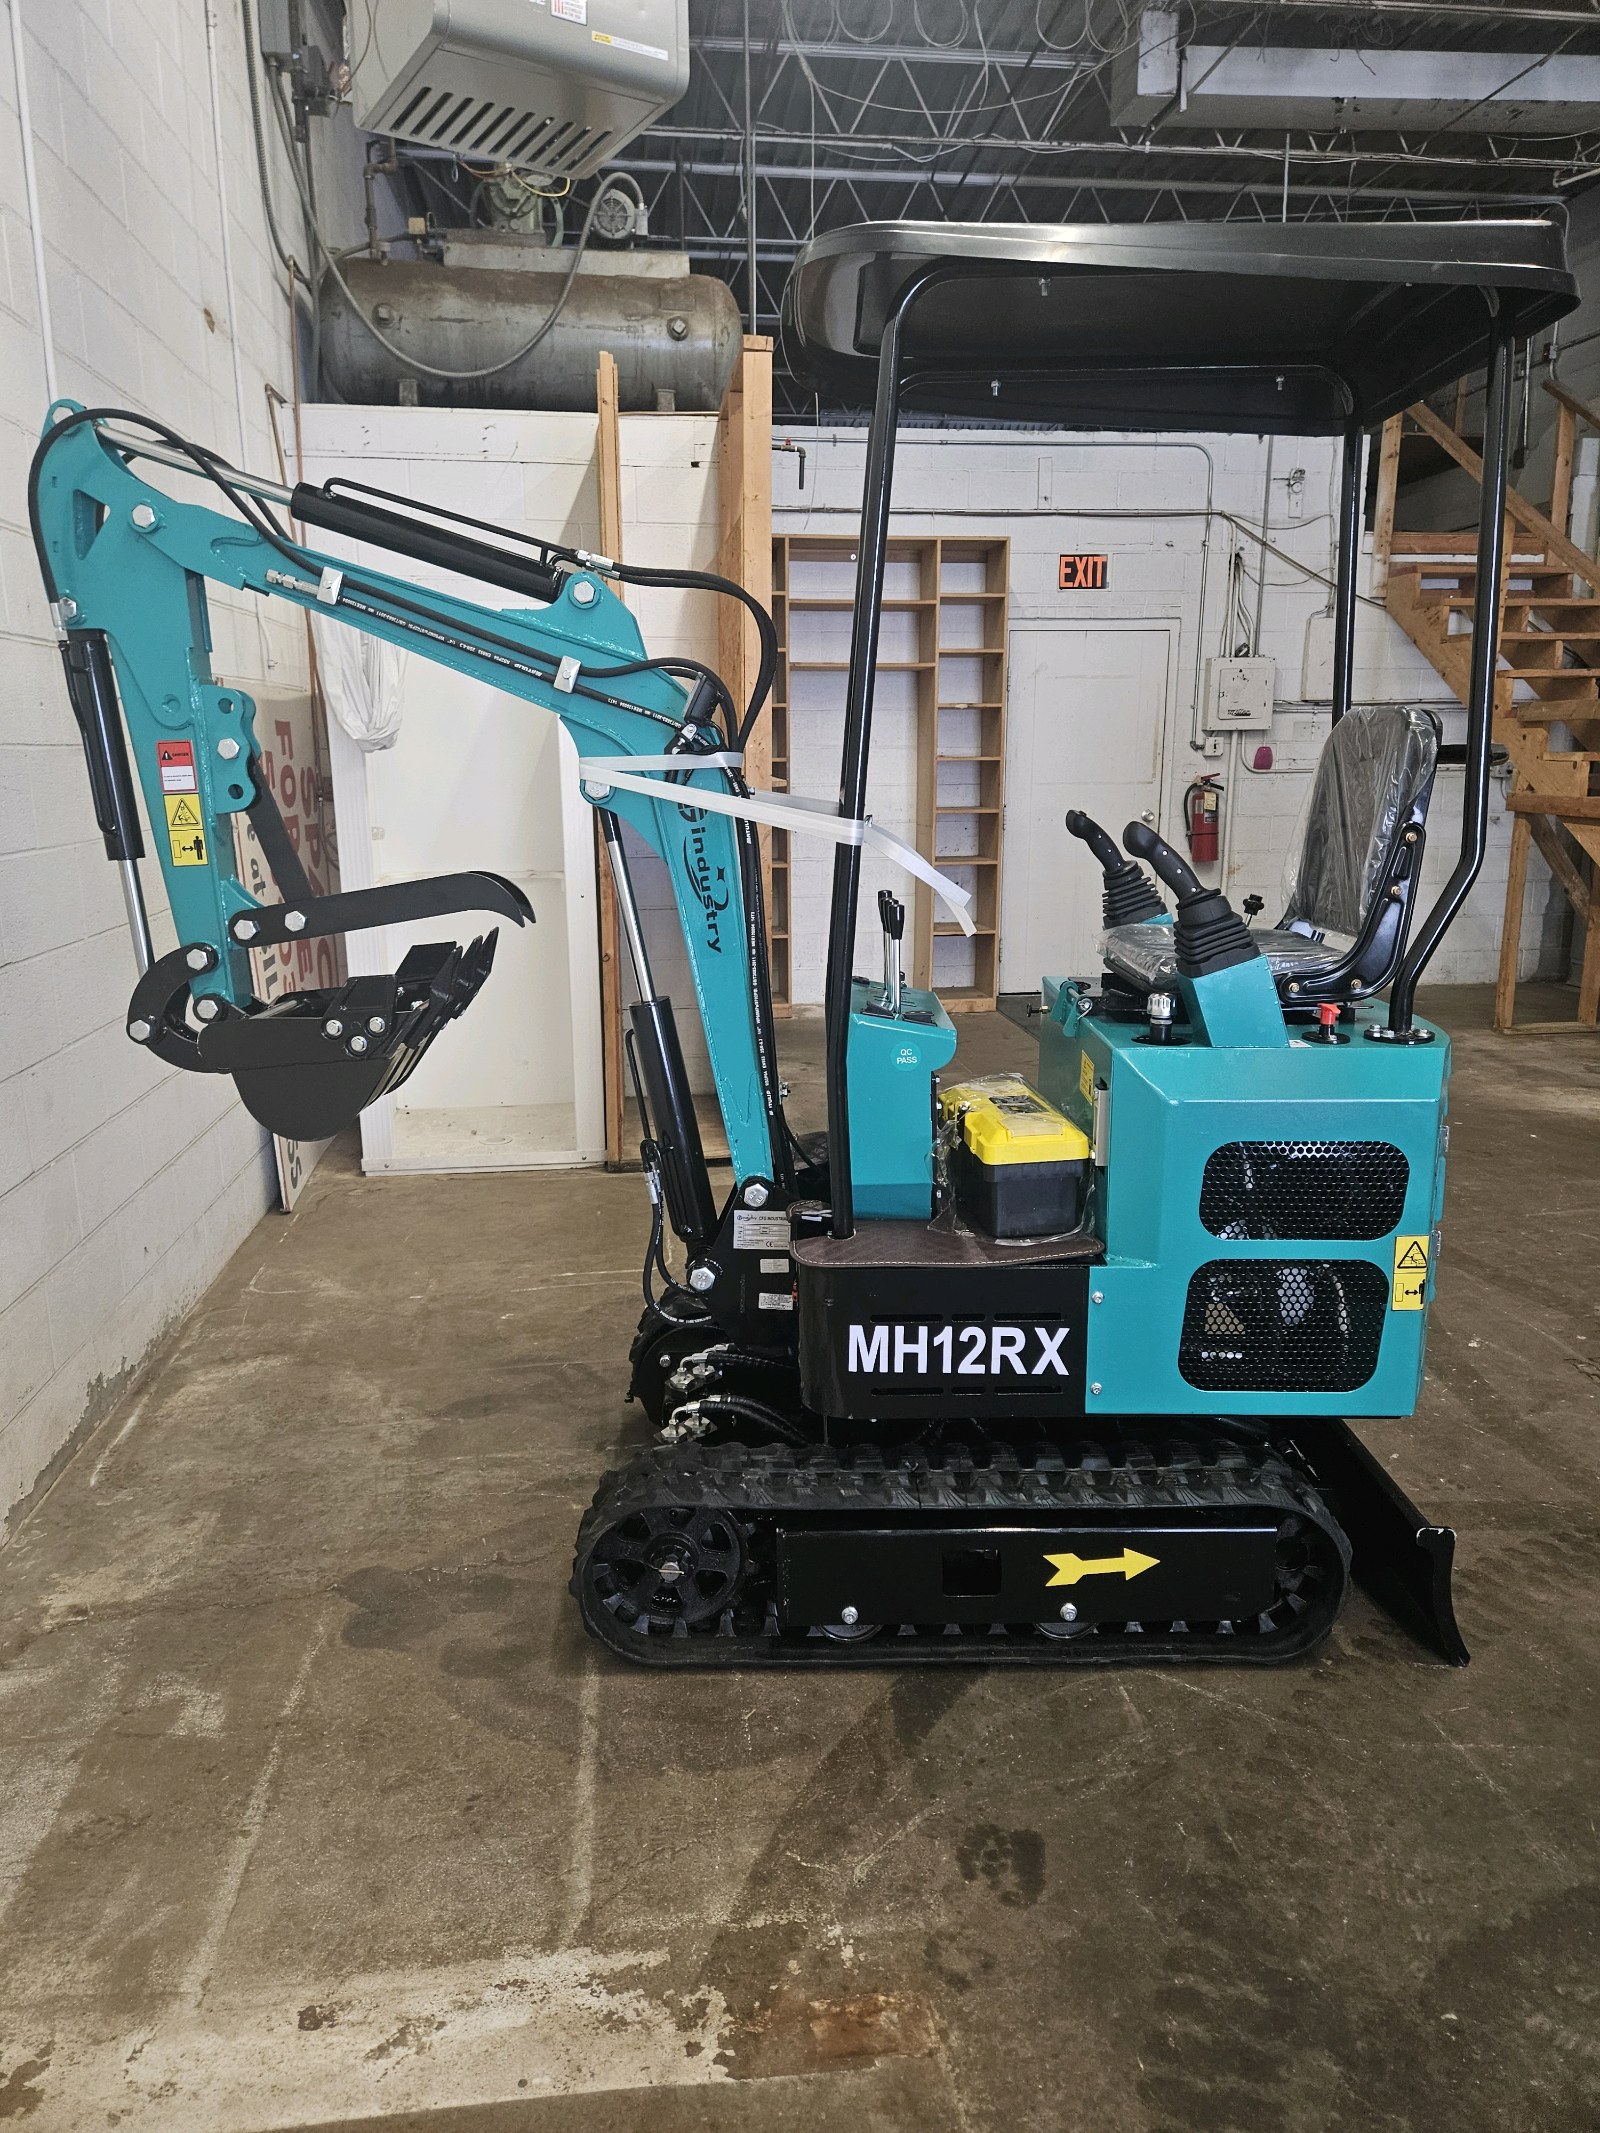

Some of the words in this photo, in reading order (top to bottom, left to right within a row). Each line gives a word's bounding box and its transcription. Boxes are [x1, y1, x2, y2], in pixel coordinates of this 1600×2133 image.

[1060, 556, 1107, 587] EXIT
[896, 1056, 917, 1064] PASS
[901, 1048, 912, 1056] QC
[848, 1324, 1070, 1376] MH12RX
